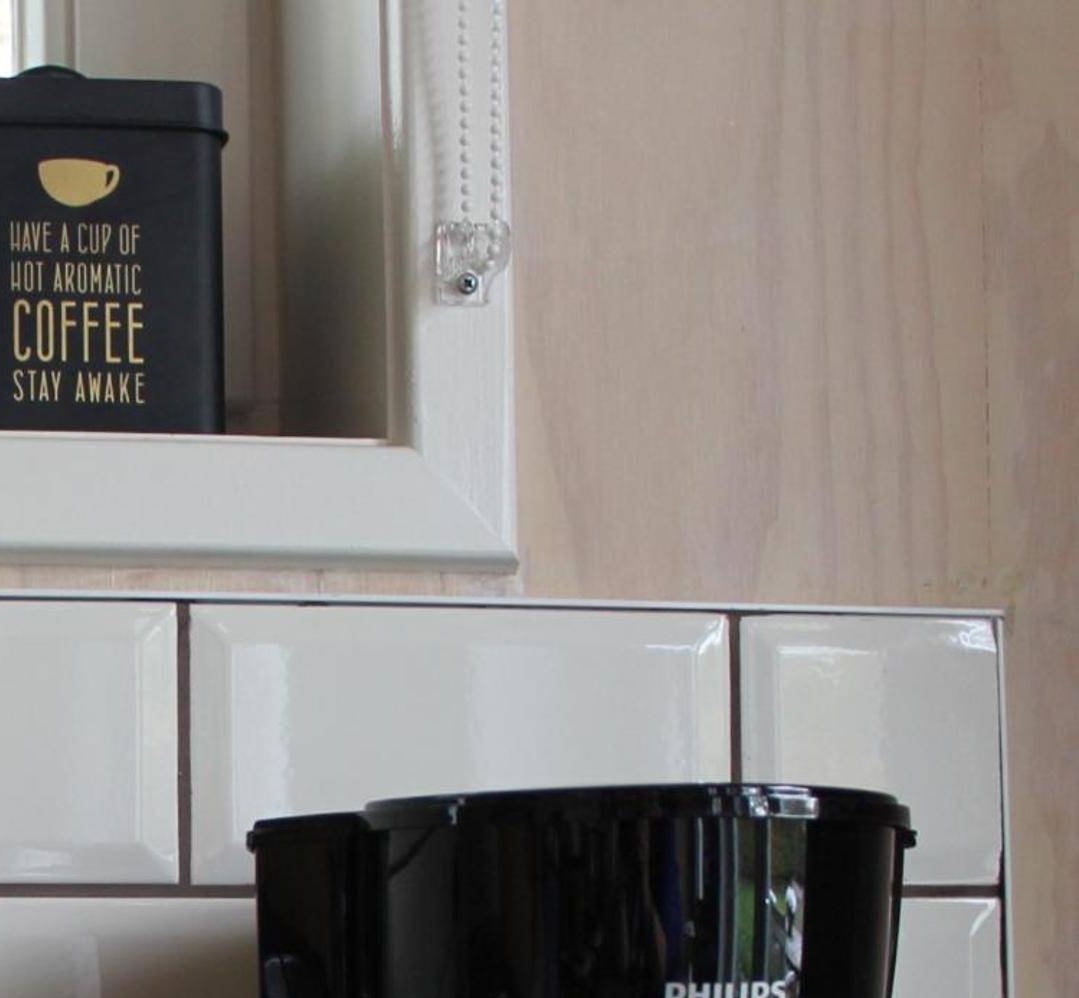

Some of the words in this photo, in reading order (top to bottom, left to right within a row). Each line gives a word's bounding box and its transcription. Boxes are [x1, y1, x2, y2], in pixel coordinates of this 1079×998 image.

[10, 221, 52, 253] HAVE
[60, 222, 70, 253] A
[77, 222, 112, 255] CUP
[119, 223, 142, 256] OF
[10, 260, 44, 293] HOT
[53, 262, 142, 296] AROMATIC
[13, 299, 145, 364] COFFEE
[13, 369, 61, 402] STAY
[75, 371, 145, 404] AWAKE
